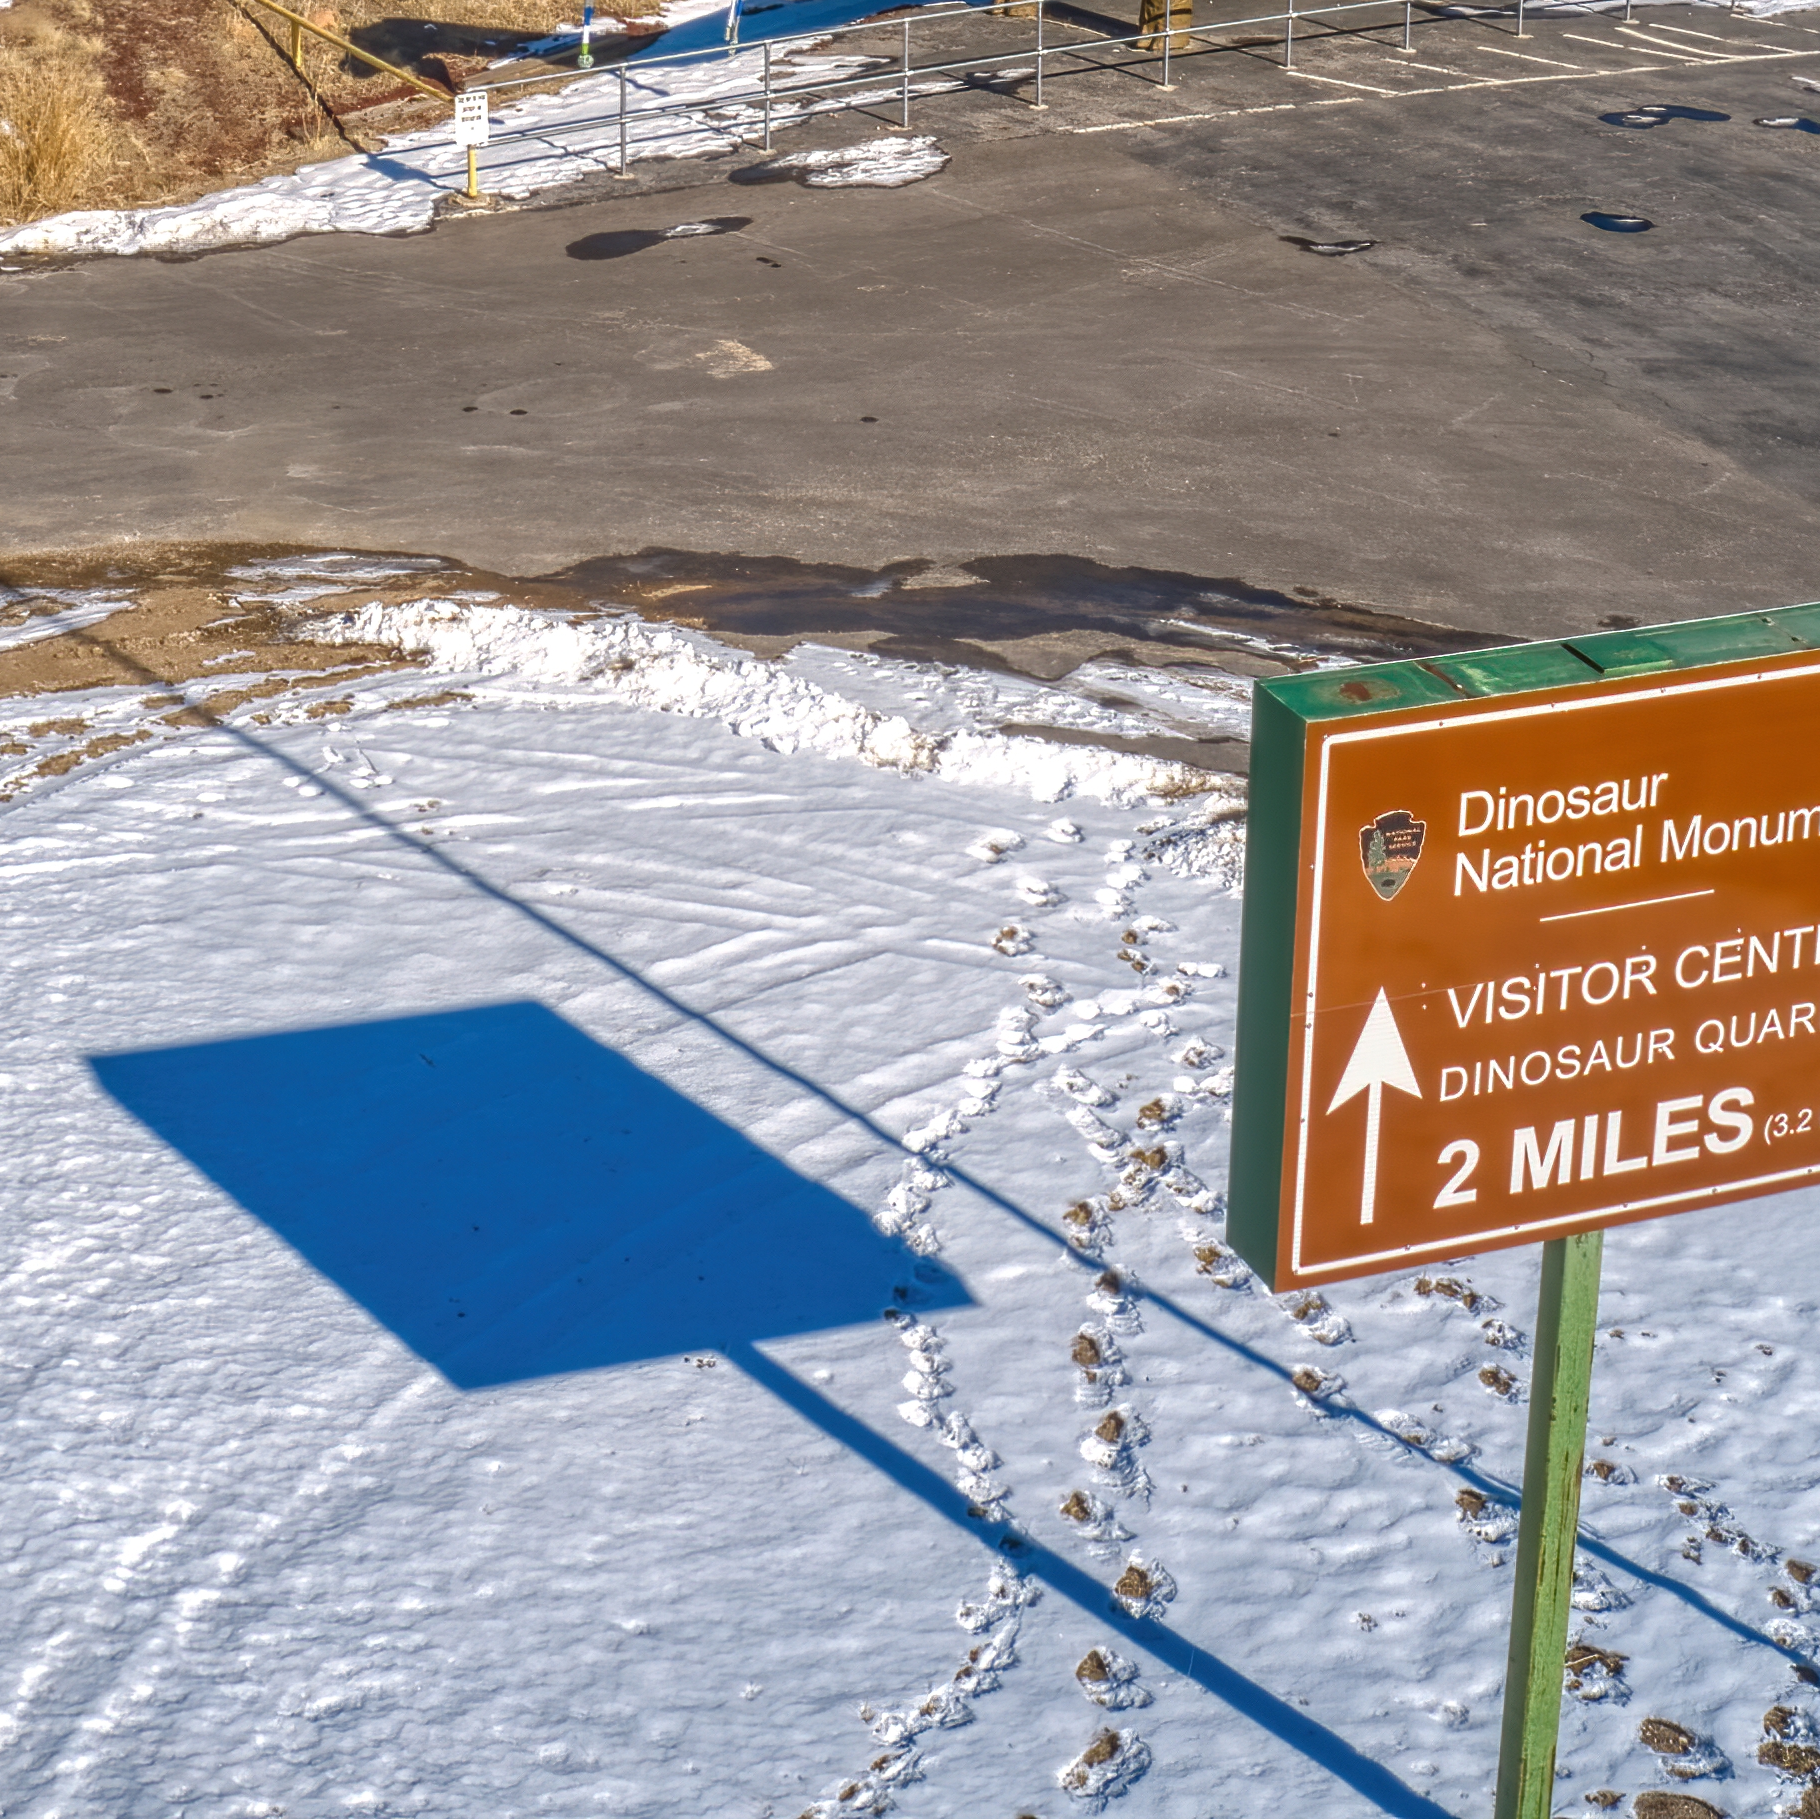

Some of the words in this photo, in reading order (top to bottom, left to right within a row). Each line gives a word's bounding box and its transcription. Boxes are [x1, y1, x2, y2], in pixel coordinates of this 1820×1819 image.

[1457, 772, 1669, 837] Dinosaur
[1453, 823, 1644, 897] National
[1447, 953, 1658, 1029] VISITOR
[1439, 1027, 1676, 1102] DINOSAUR
[1432, 1138, 1481, 1210] 2
[1509, 1085, 1756, 1196] MILES
[1762, 1109, 1813, 1146] (3.2
